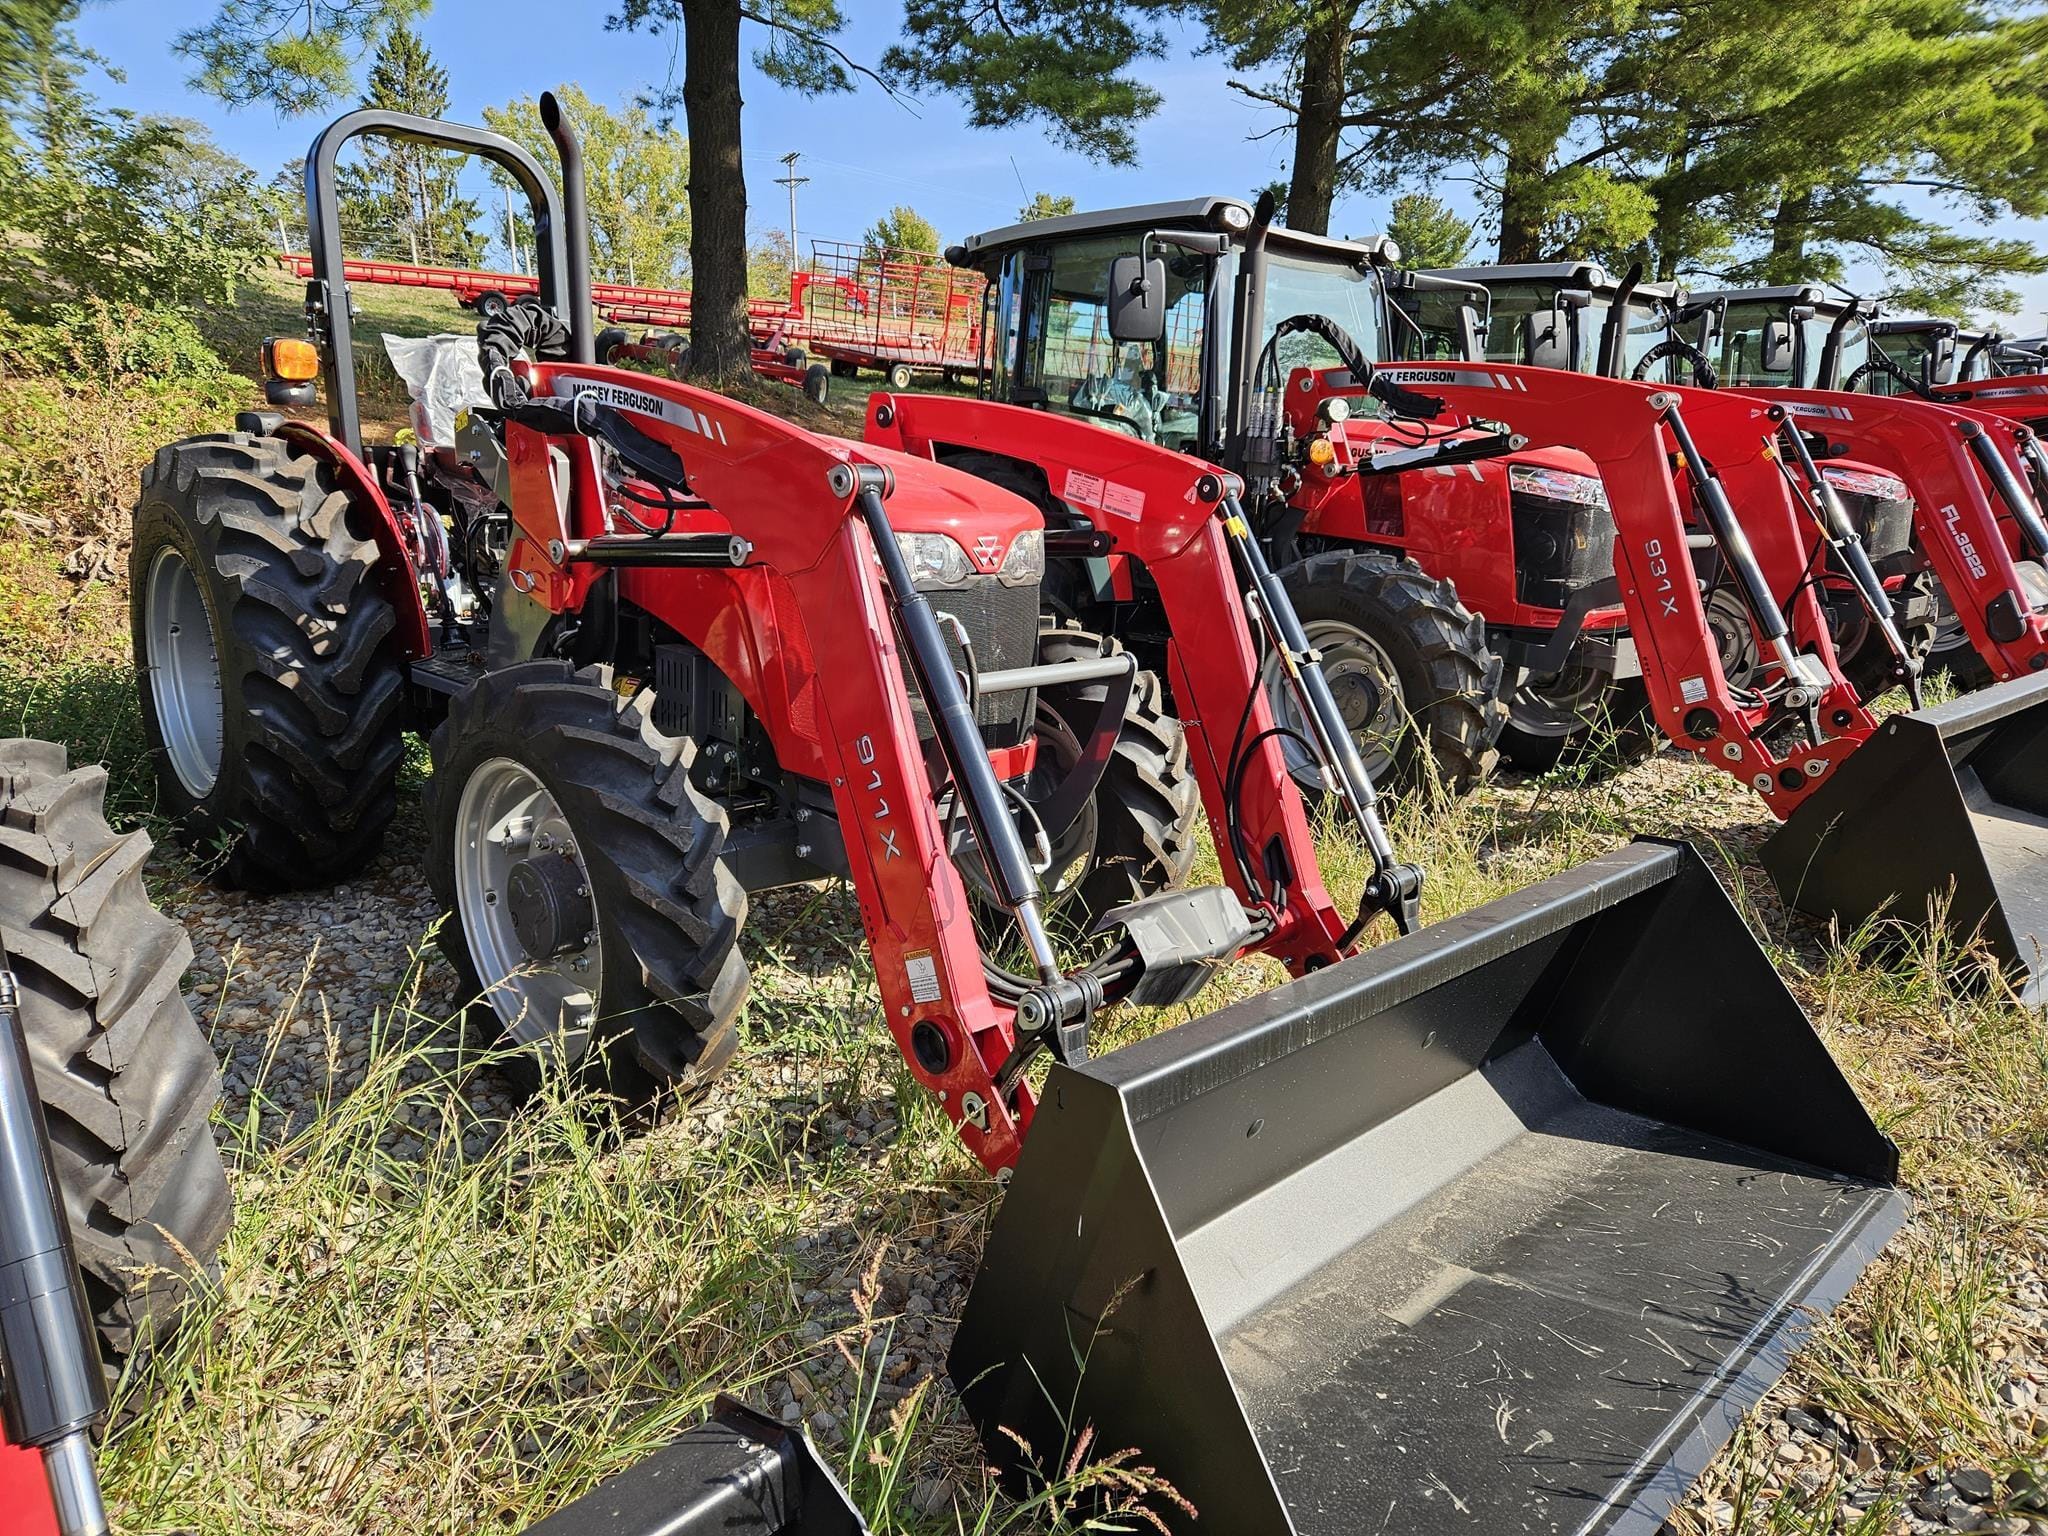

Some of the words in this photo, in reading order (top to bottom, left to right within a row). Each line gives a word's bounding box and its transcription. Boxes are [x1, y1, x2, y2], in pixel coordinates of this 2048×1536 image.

[612, 389, 663, 416] FERGUSON
[1397, 371, 1456, 382] FERGUSON
[1644, 538, 1679, 617] 931X
[856, 734, 901, 863] 911X
